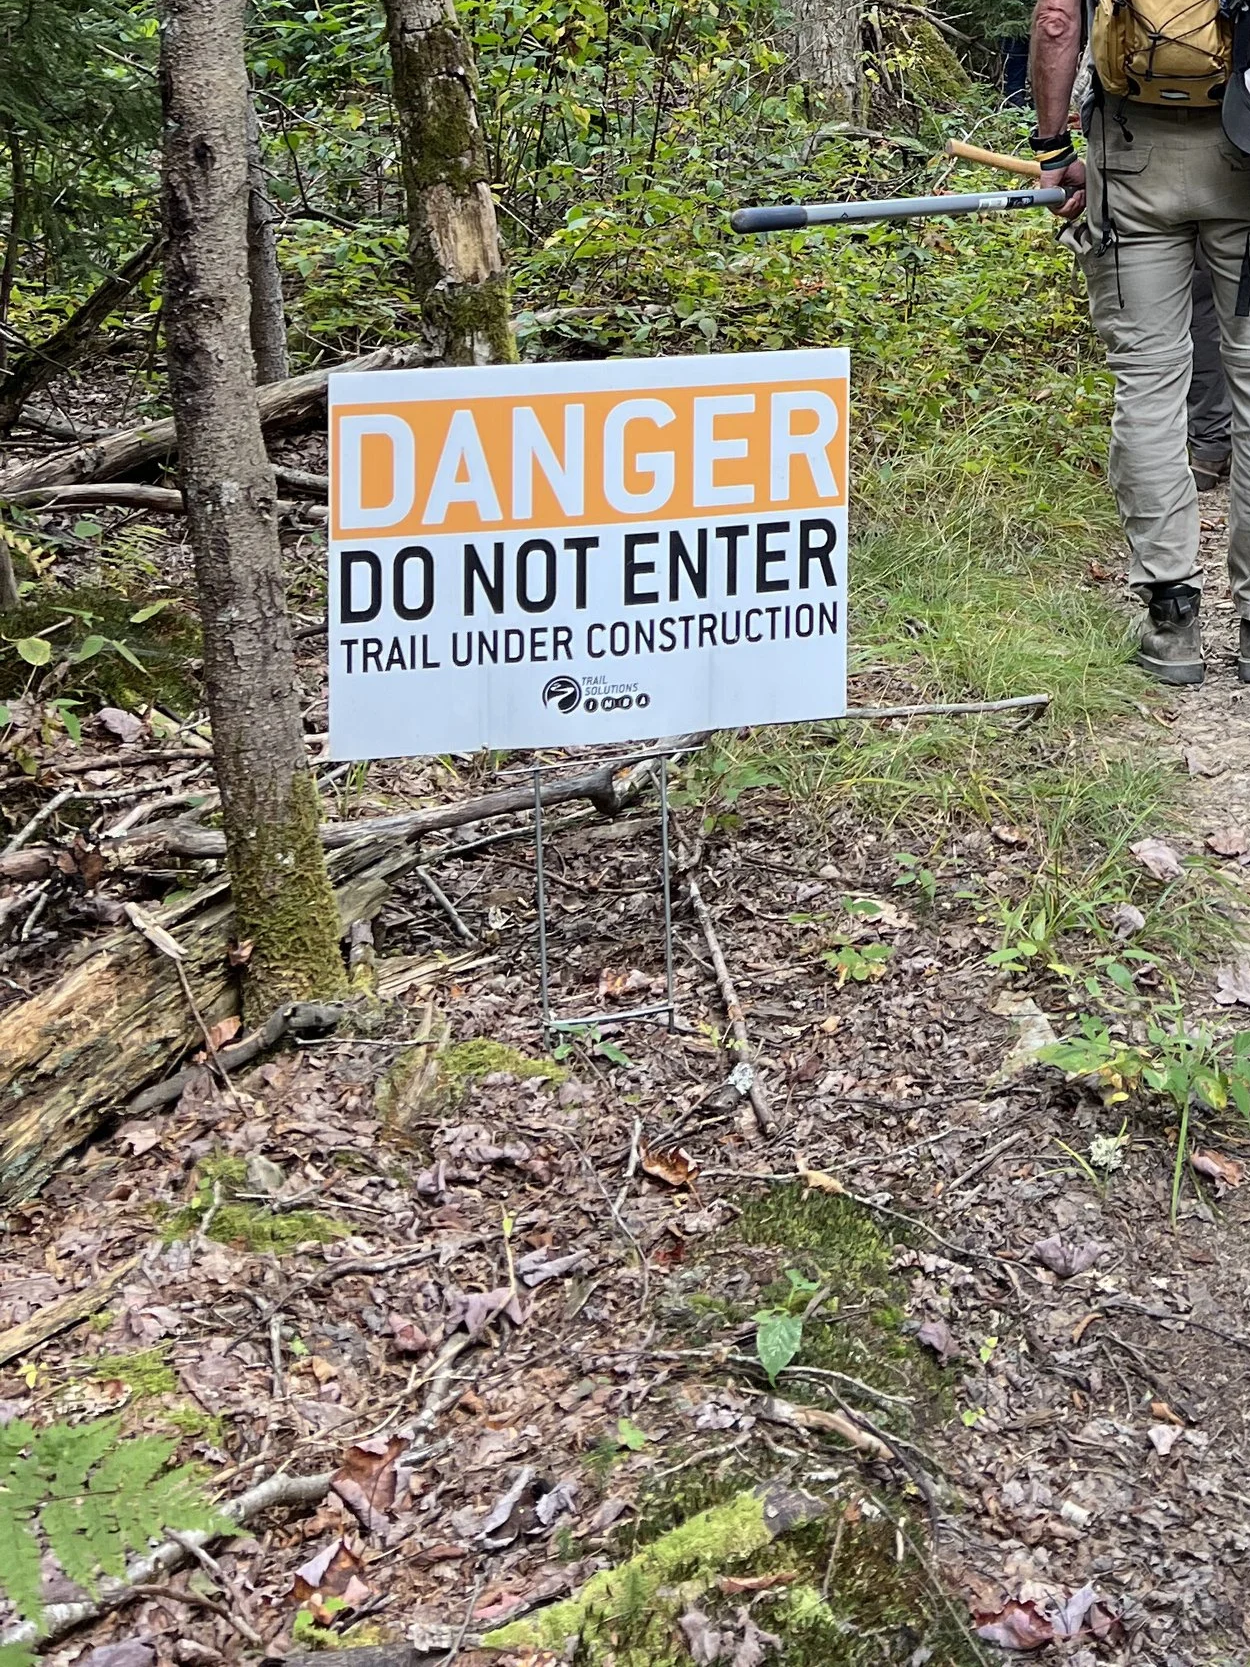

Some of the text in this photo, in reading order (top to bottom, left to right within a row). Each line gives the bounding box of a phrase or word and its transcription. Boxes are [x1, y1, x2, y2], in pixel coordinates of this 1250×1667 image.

[339, 390, 839, 530] DANGER
[341, 519, 837, 624] DO NOT ENTER
[341, 602, 838, 674] TRAIL UNDER CONSTRUCTION
[582, 675, 607, 686] TRAIL
[585, 683, 639, 696] SOLUTIONS
